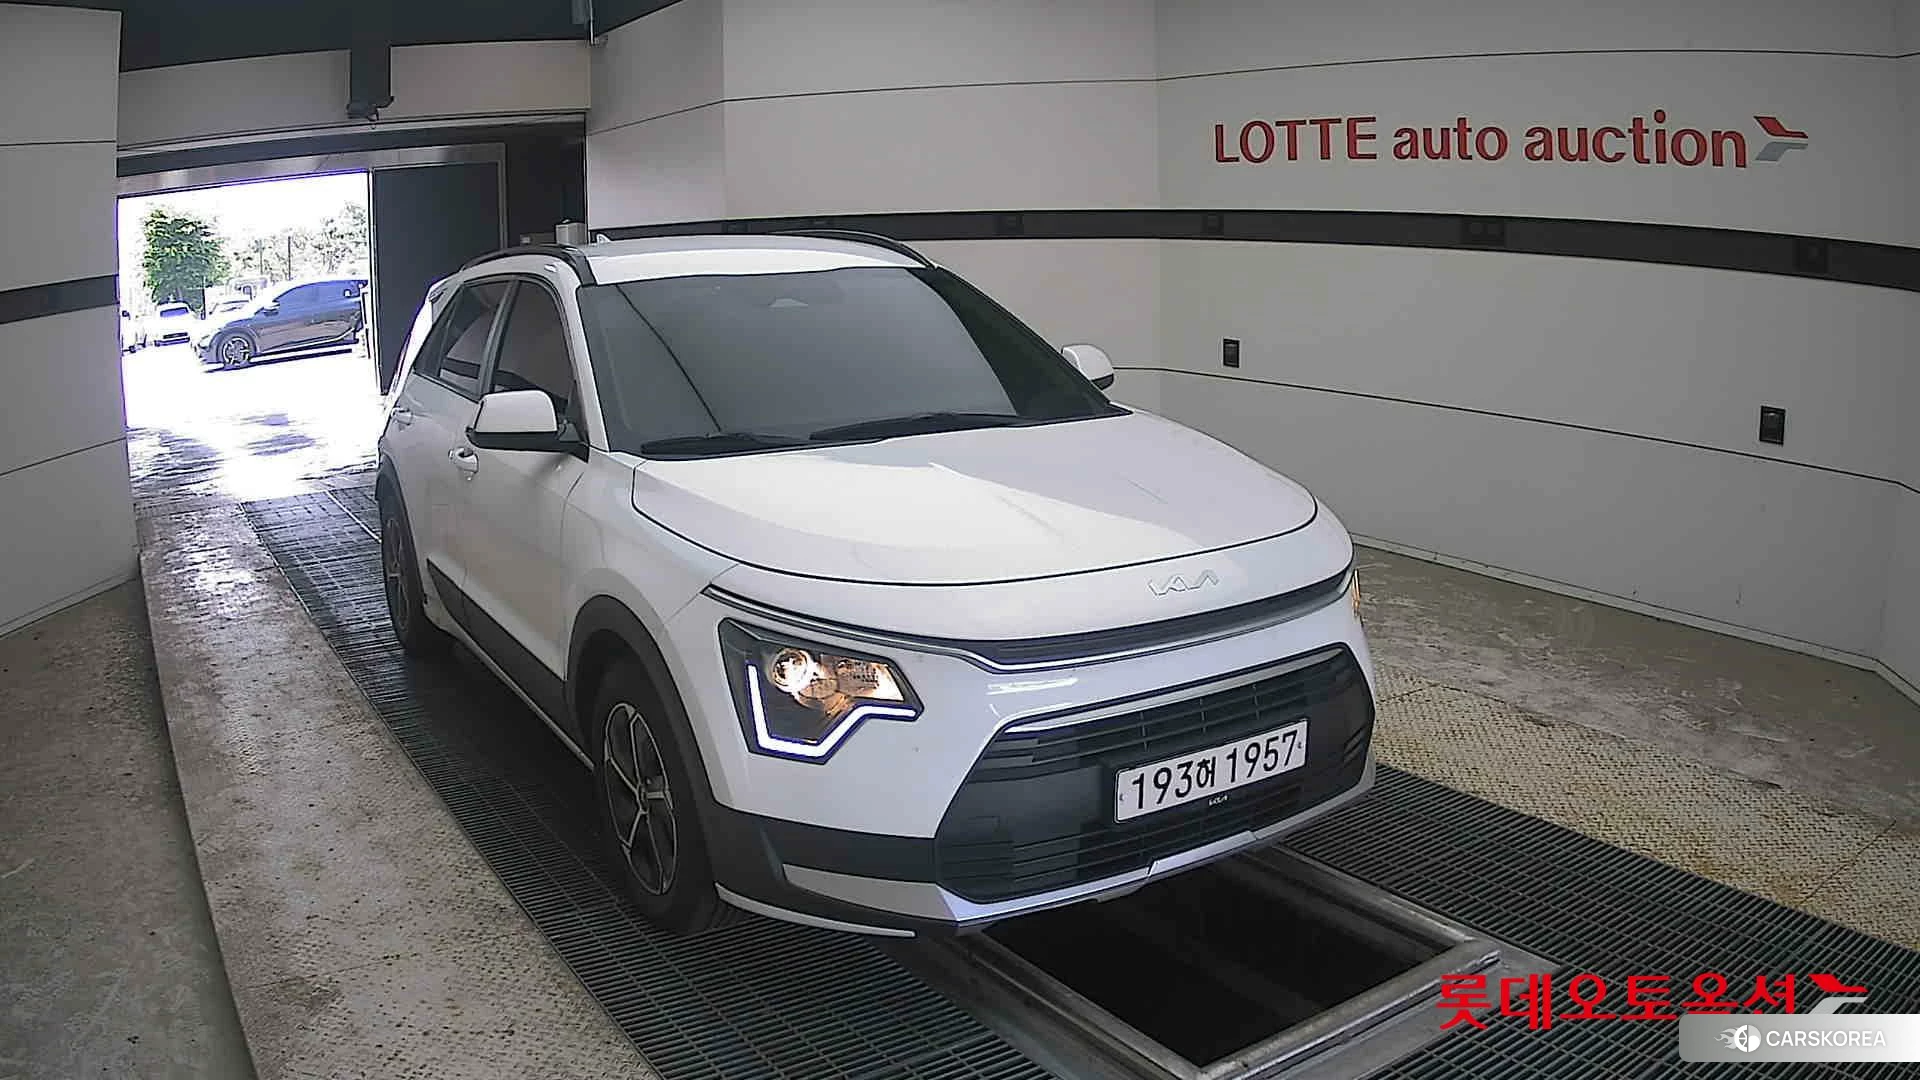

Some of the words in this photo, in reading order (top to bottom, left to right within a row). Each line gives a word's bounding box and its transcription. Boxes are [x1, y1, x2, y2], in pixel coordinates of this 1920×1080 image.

[1214, 116, 1378, 164] LOTTE
[1392, 117, 1509, 162] auto
[1523, 109, 1748, 168] auction
[1132, 756, 1216, 809] 193허
[1226, 730, 1298, 783] 1957
